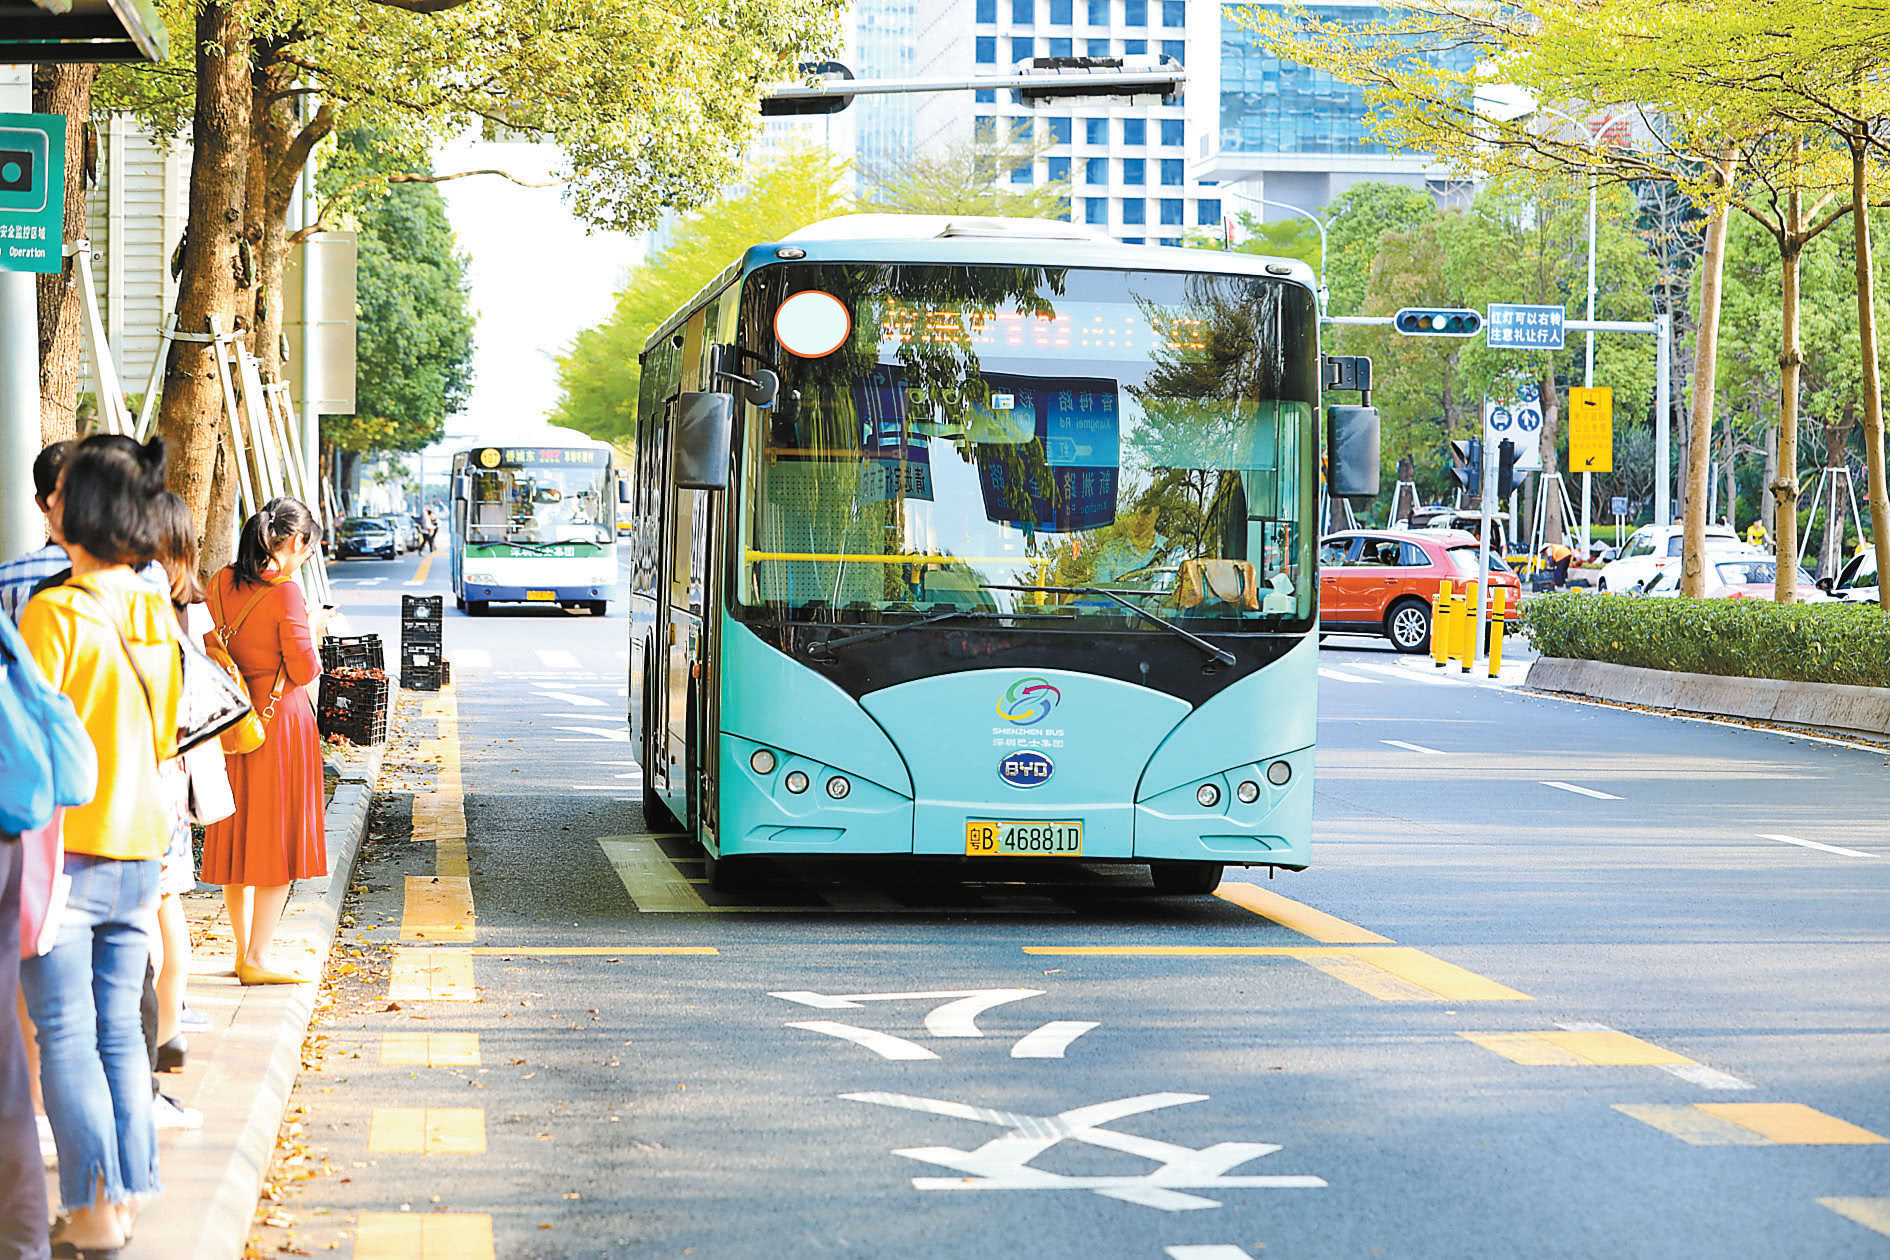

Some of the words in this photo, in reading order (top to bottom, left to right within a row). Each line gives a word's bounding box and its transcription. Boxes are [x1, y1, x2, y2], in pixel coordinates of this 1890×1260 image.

[9, 246, 46, 258] Operation
[1490, 311, 1561, 327] 红灯可以右转
[1490, 327, 1560, 343] 注意礼让行人
[992, 728, 1043, 736] SHENZHEN
[992, 738, 1065, 748] 深圳巴士集团
[1005, 761, 1048, 777] BYD
[1004, 828, 1079, 851] 46881D
